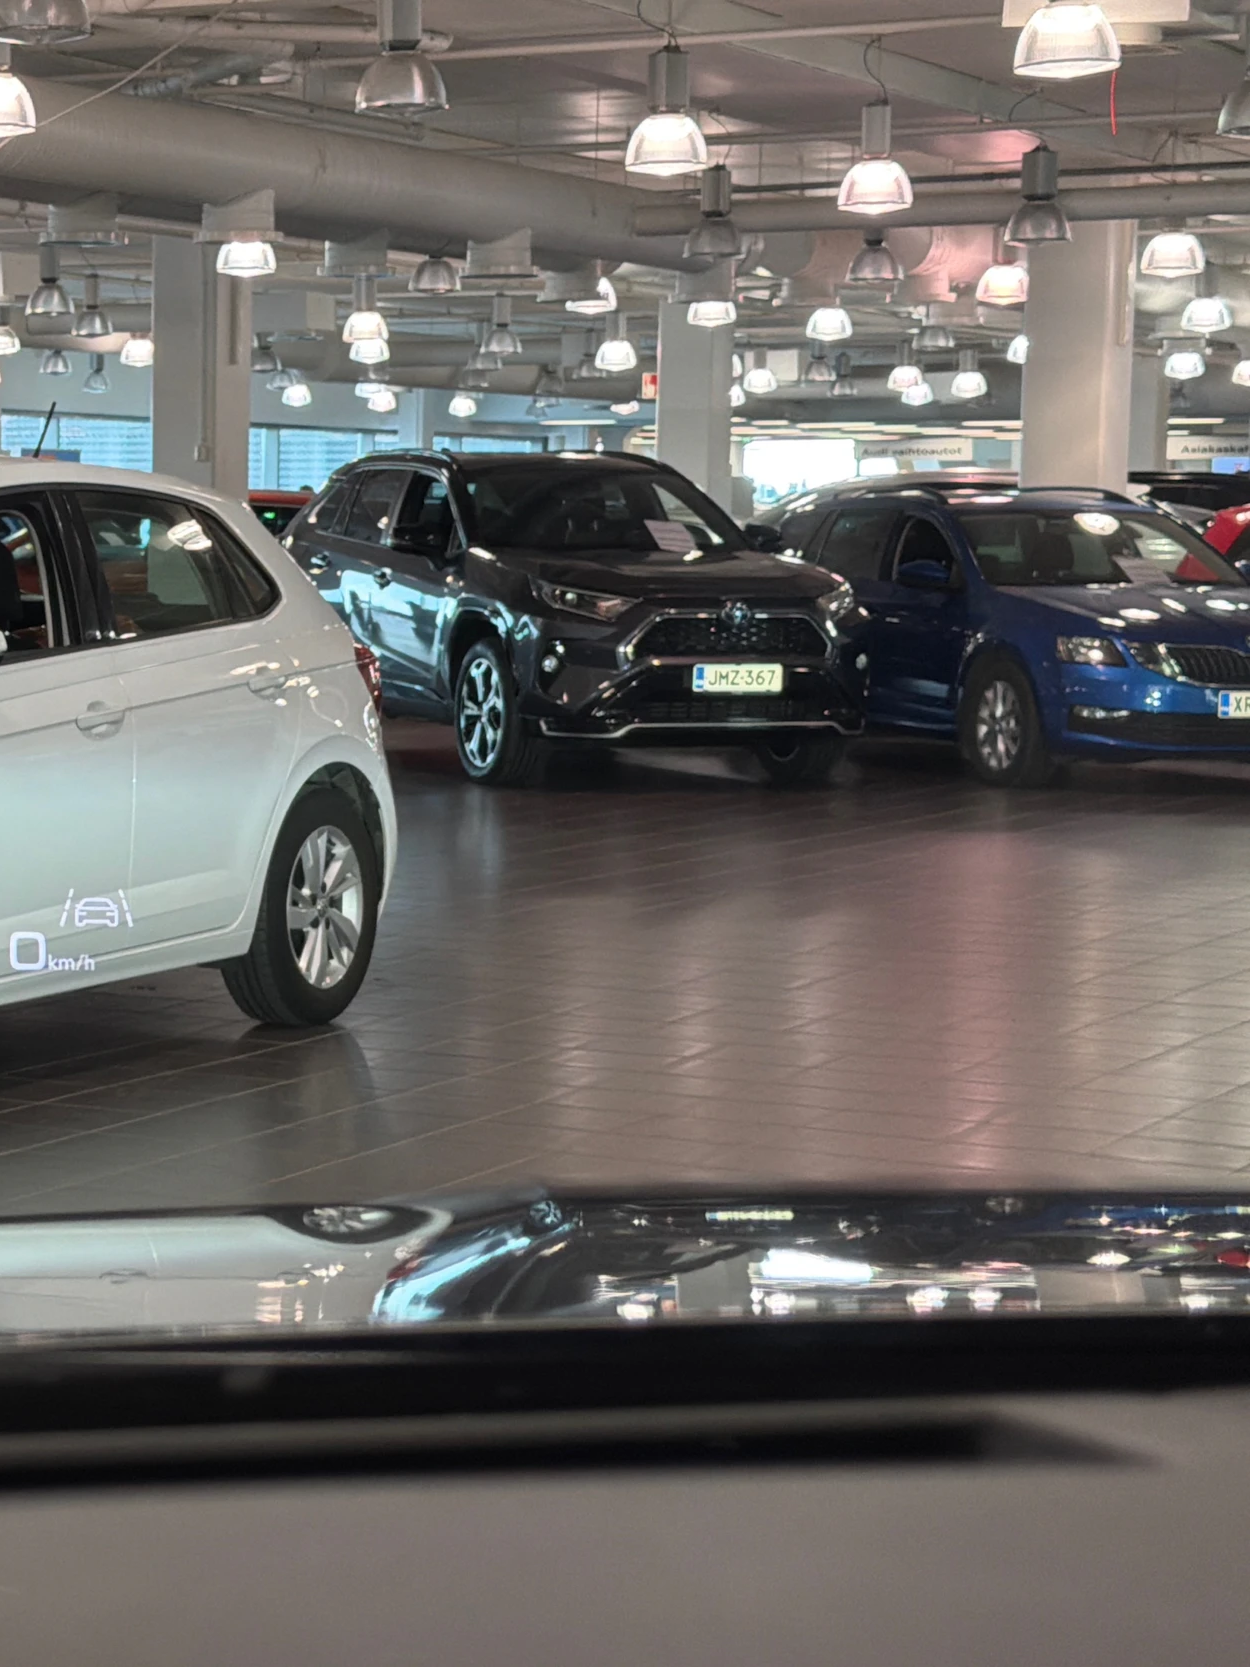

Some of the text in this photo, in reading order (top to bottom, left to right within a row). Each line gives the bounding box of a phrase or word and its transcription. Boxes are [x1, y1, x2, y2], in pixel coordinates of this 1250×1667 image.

[708, 669, 776, 686] JMZ-367
[9, 932, 95, 971] 0 km/h
